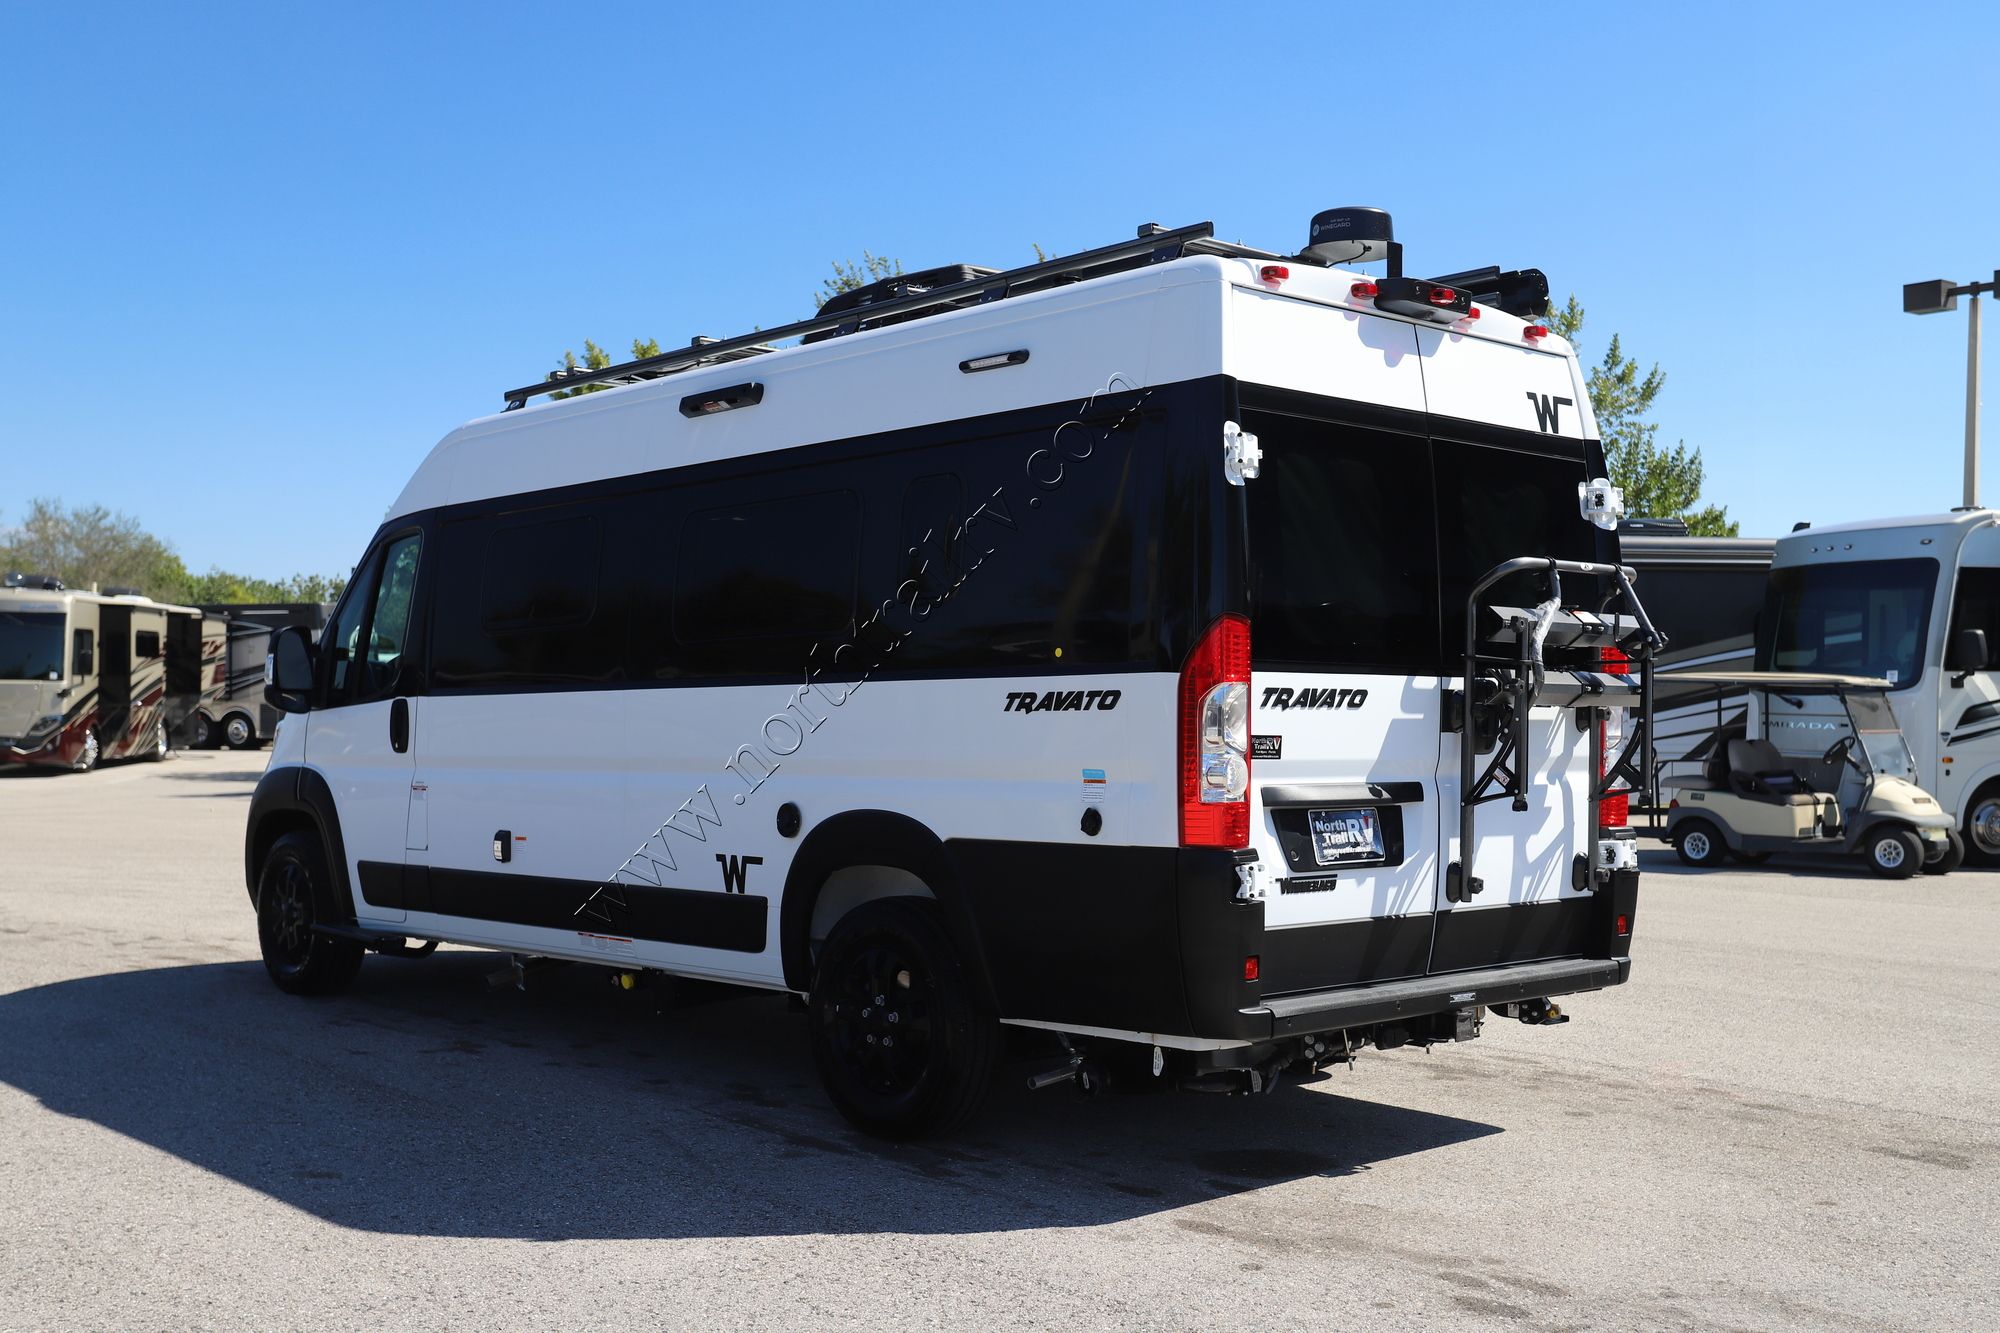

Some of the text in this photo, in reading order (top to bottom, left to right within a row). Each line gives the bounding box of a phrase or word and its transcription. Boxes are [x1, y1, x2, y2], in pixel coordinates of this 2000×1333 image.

[1321, 221, 1351, 231] WINEGARD
[1003, 689, 1122, 715] TRAVATO
[1259, 687, 1369, 712] TRAVATO
[1768, 720, 1837, 731] MIRADA
[1266, 736, 1281, 750] RV
[1315, 820, 1347, 832] North
[1346, 818, 1374, 844] RV
[1322, 831, 1349, 847] Trail
